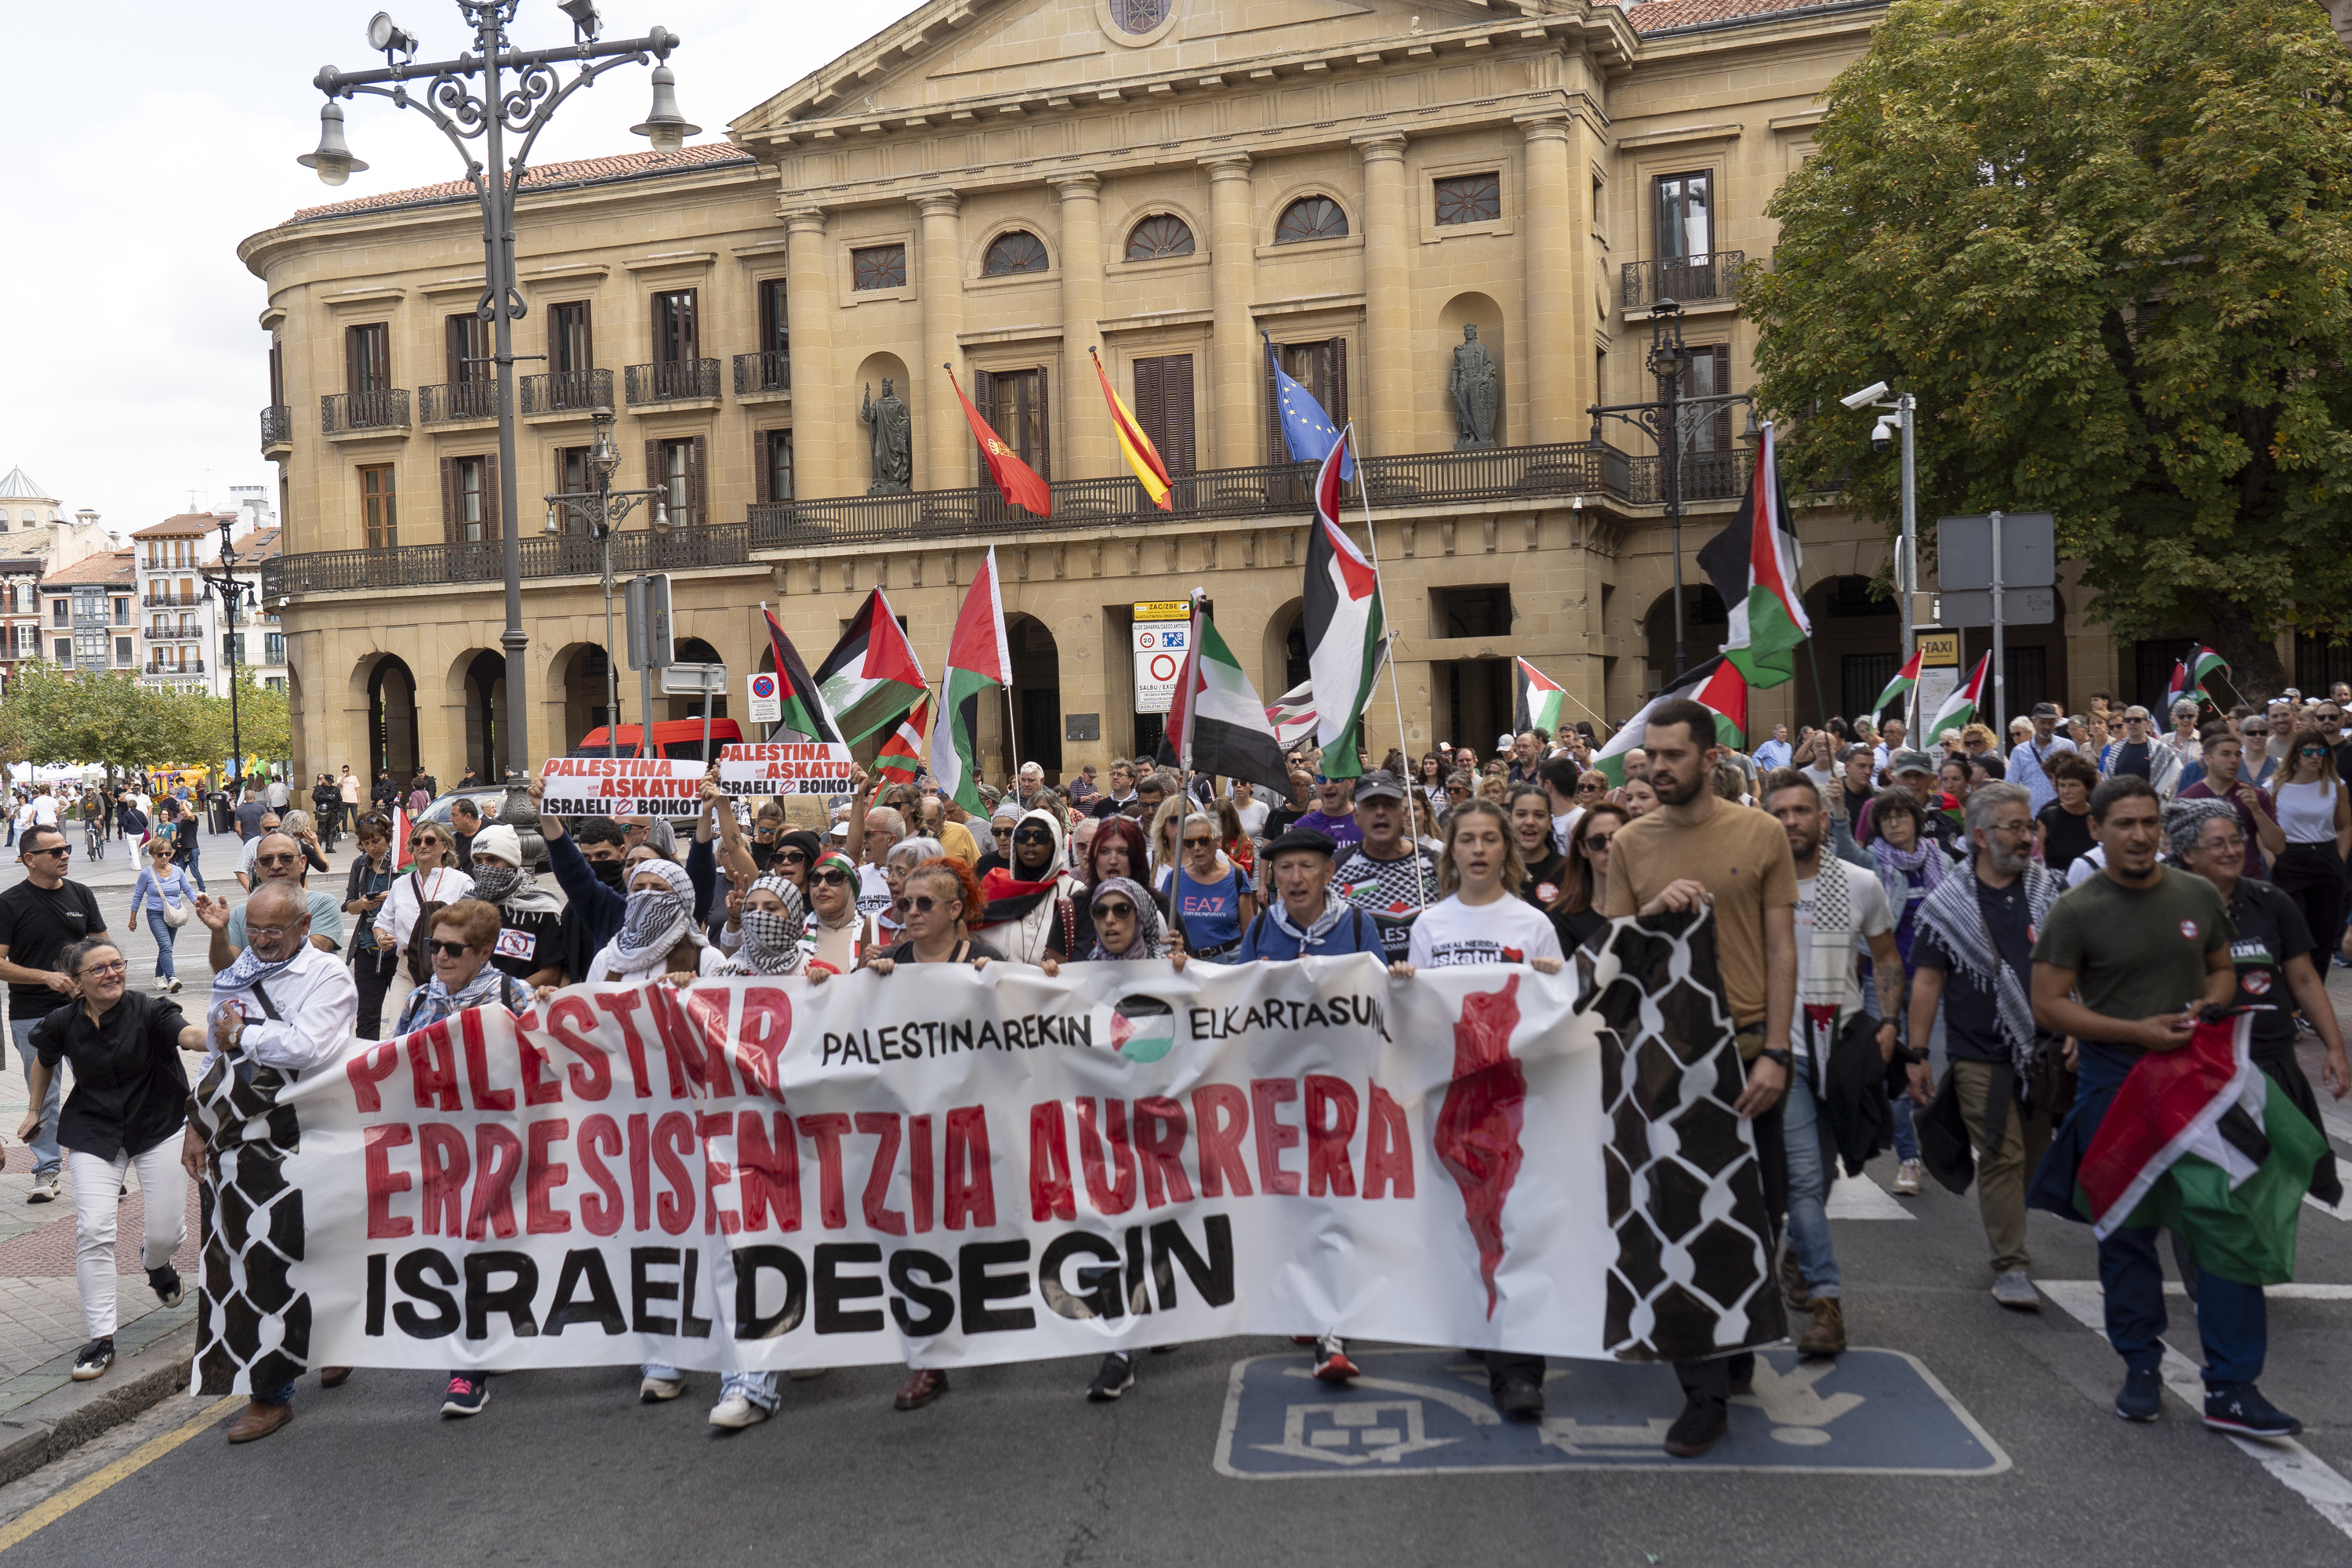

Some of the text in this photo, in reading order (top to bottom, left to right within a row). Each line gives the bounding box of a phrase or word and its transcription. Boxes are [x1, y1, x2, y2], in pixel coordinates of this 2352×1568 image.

[1924, 641, 1952, 653] TAXI
[720, 744, 831, 761] PALESTINA
[544, 760, 672, 777] PALESTINA
[766, 762, 853, 779] ASKATU
[600, 779, 702, 798] ASKATU!
[800, 779, 858, 793] BOIKOT
[543, 798, 702, 815] ISRAELI BOIKOT
[1184, 896, 1225, 912] EA7
[822, 1014, 1092, 1067] PALESTINAREKIN
[364, 1073, 1416, 1242] ERRESISTENTZIA AURRERA
[365, 1214, 1235, 1340] ISRAEL DESEGIN
